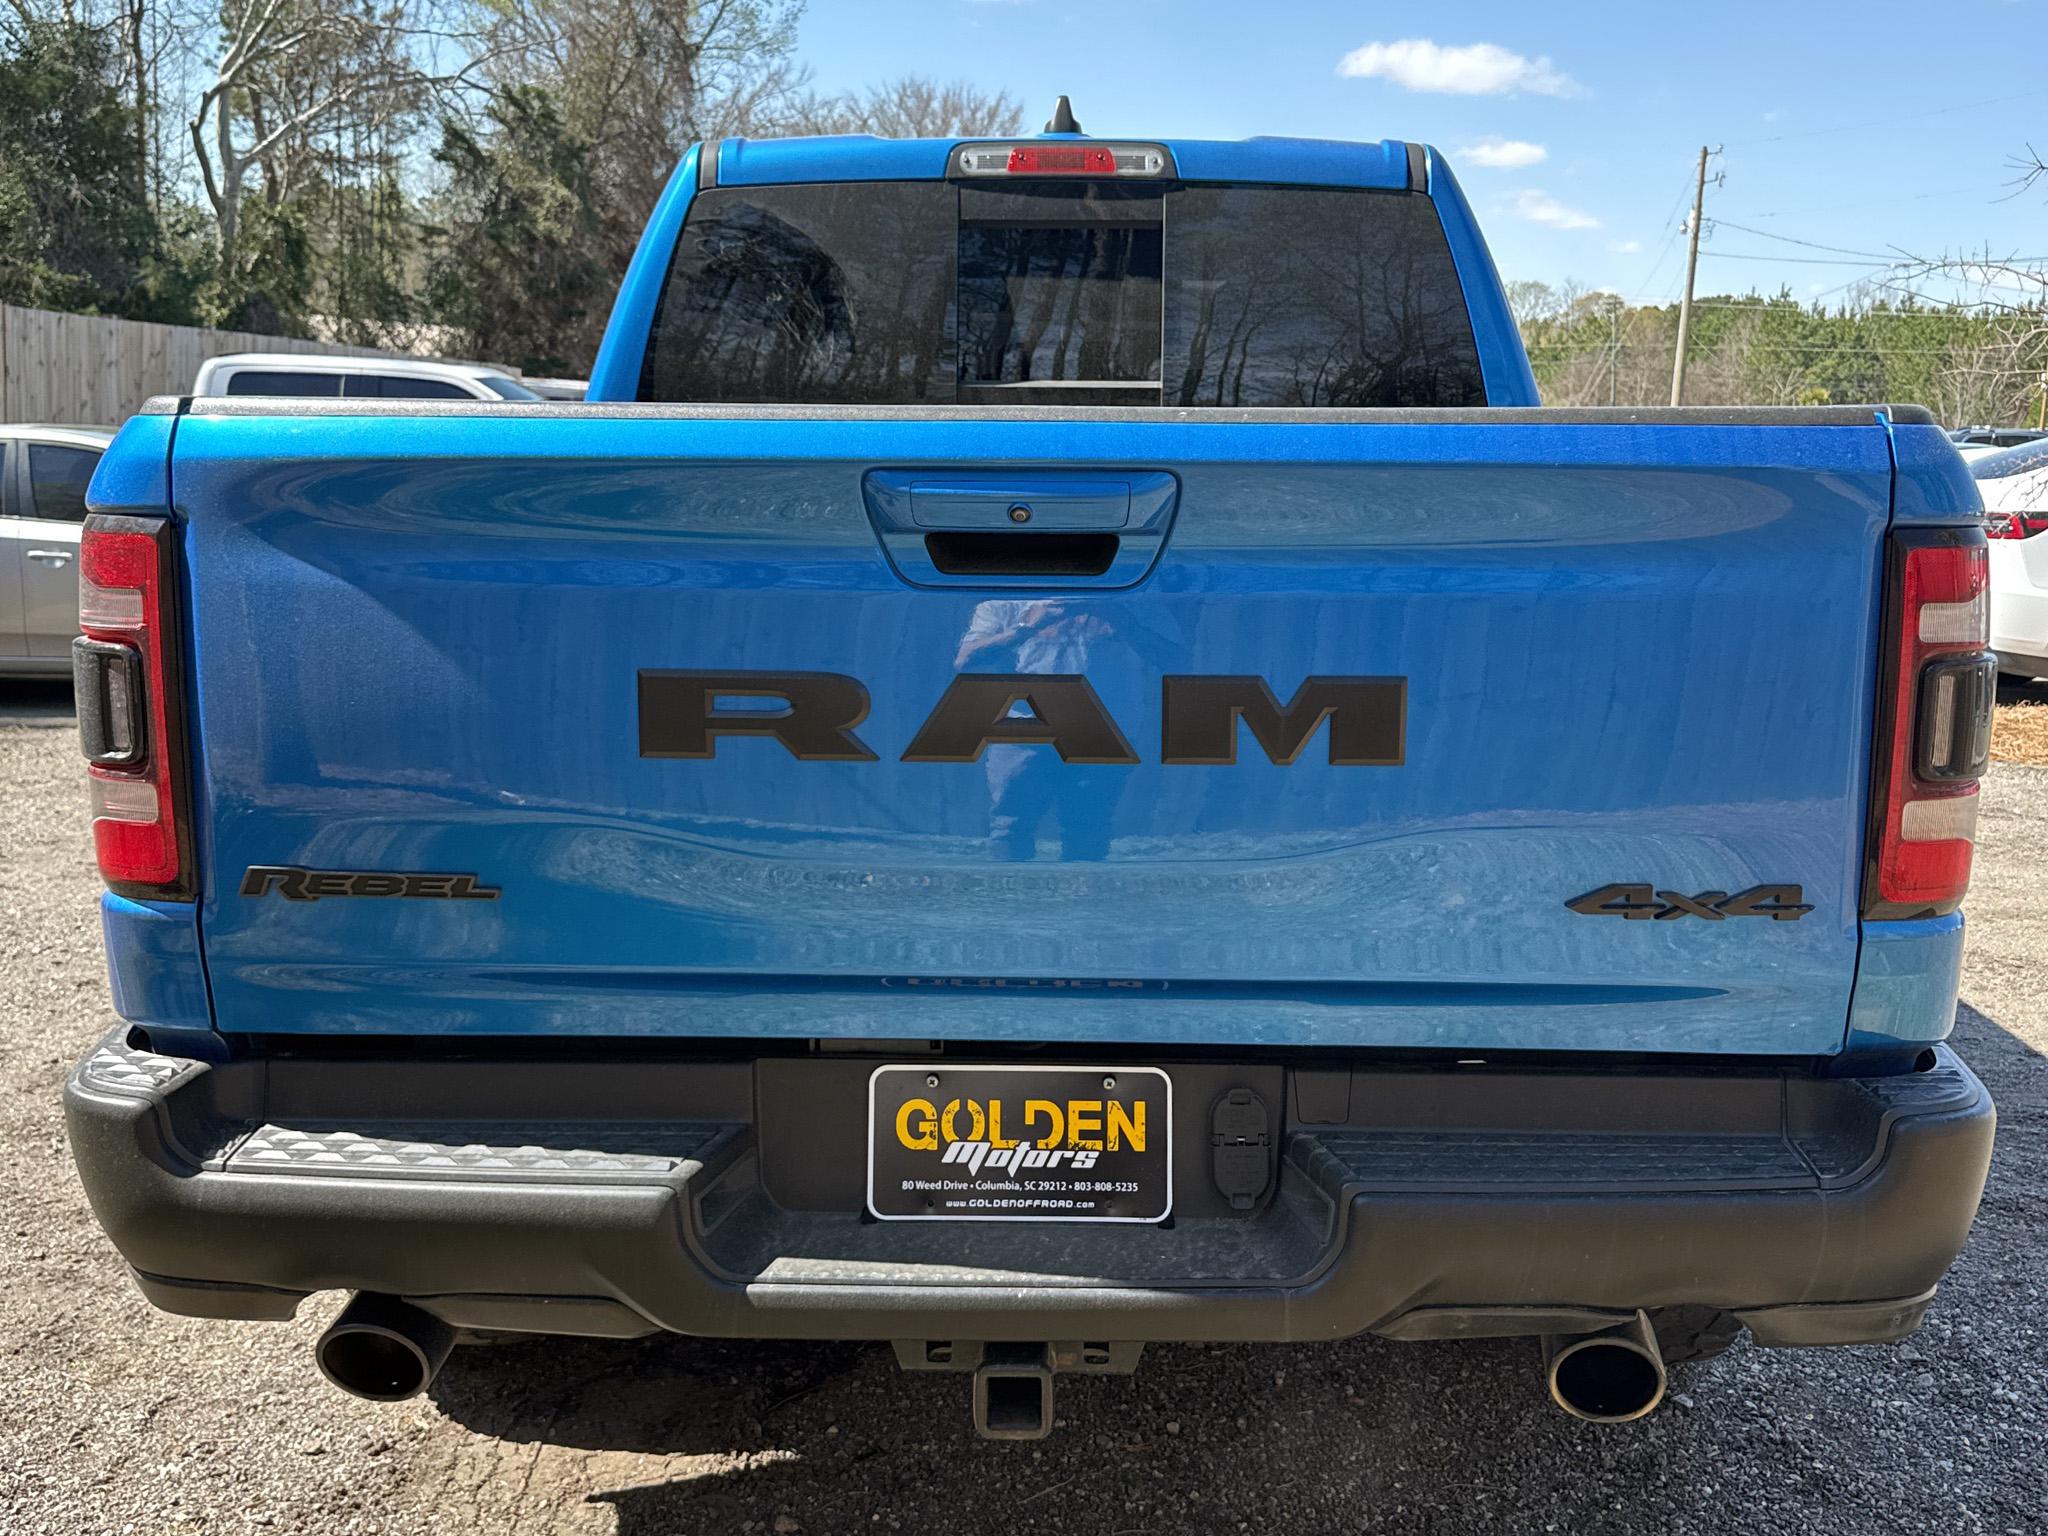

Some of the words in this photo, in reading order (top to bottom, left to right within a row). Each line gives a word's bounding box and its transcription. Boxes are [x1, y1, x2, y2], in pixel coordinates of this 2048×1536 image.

[637, 668, 1407, 766] RAM
[240, 865, 501, 901] REBEL
[895, 1098, 1146, 1152] GOLDEN
[902, 1181, 915, 1191] 80
[916, 1181, 943, 1191] Weed
[944, 1180, 968, 1191] Drive
[975, 1180, 1023, 1192] Columbia,
[1024, 1181, 1037, 1192] SC
[1037, 1181, 1067, 1192] 29212
[1074, 1181, 1138, 1192] 803-808-5235
